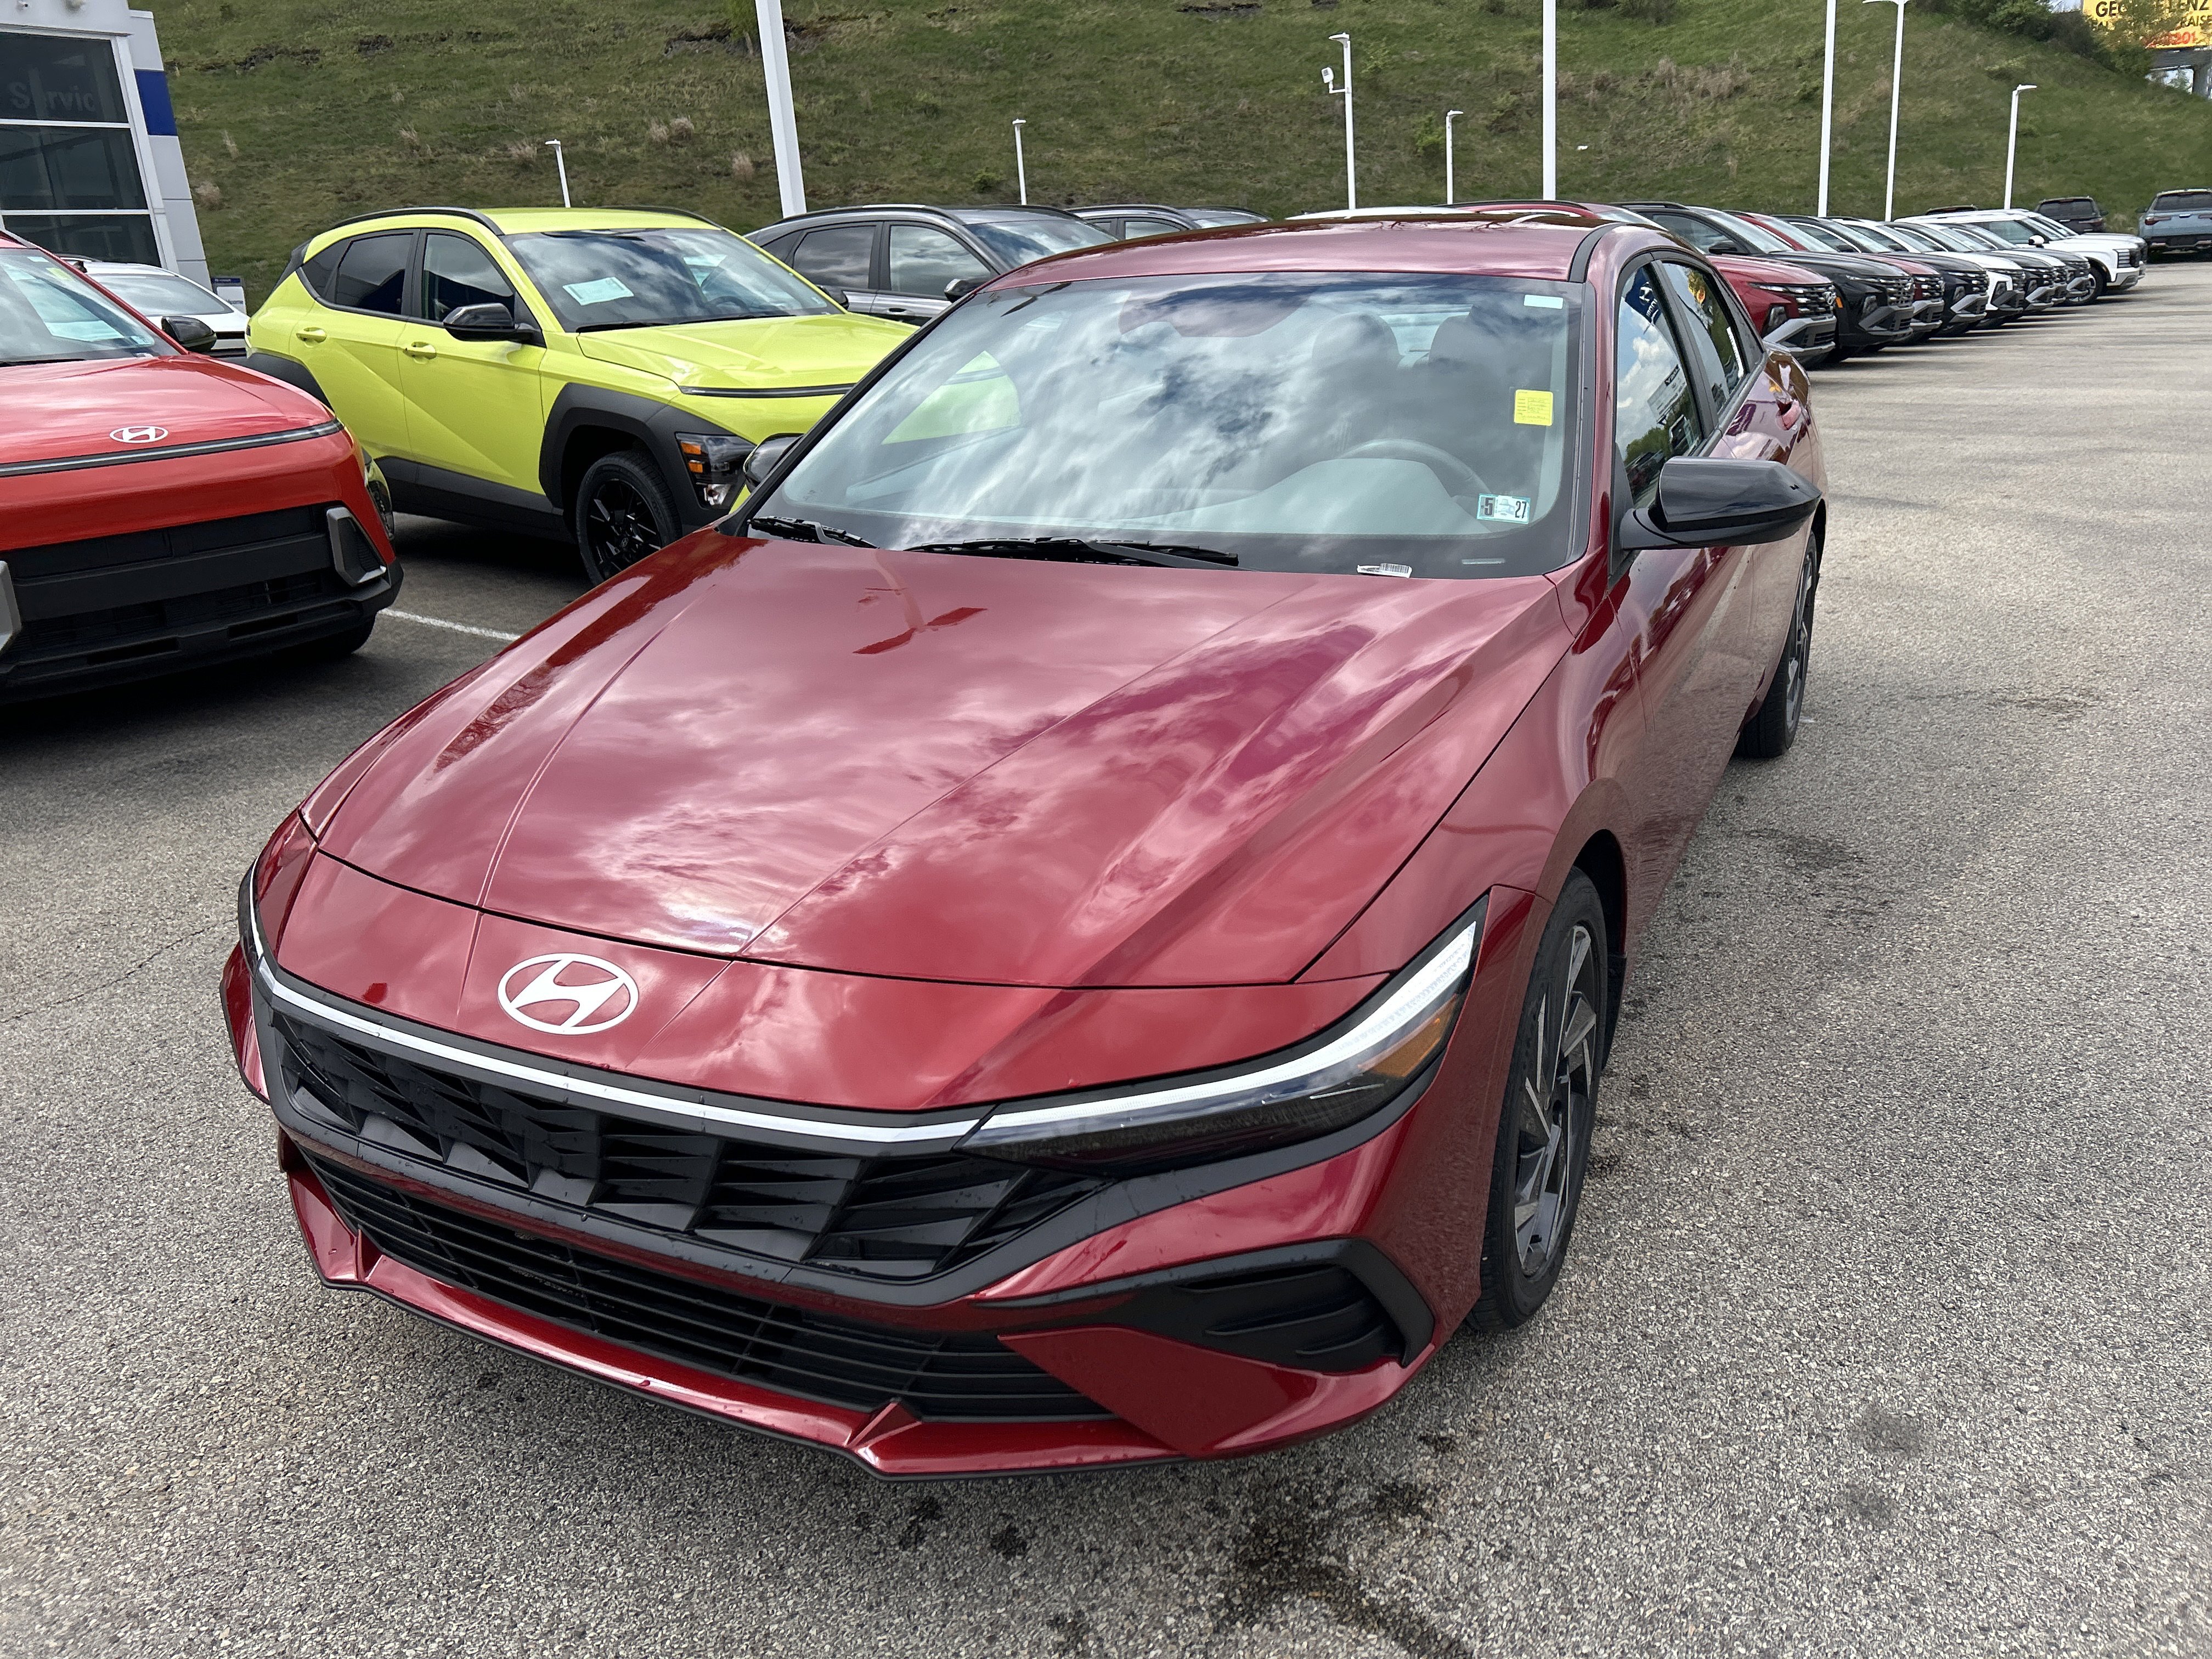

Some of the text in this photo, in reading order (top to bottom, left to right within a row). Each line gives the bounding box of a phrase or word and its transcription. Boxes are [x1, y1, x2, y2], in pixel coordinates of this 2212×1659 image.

[8, 82, 97, 112] Srvic
[1484, 498, 1493, 516] 5
[1515, 500, 1527, 518] 27
